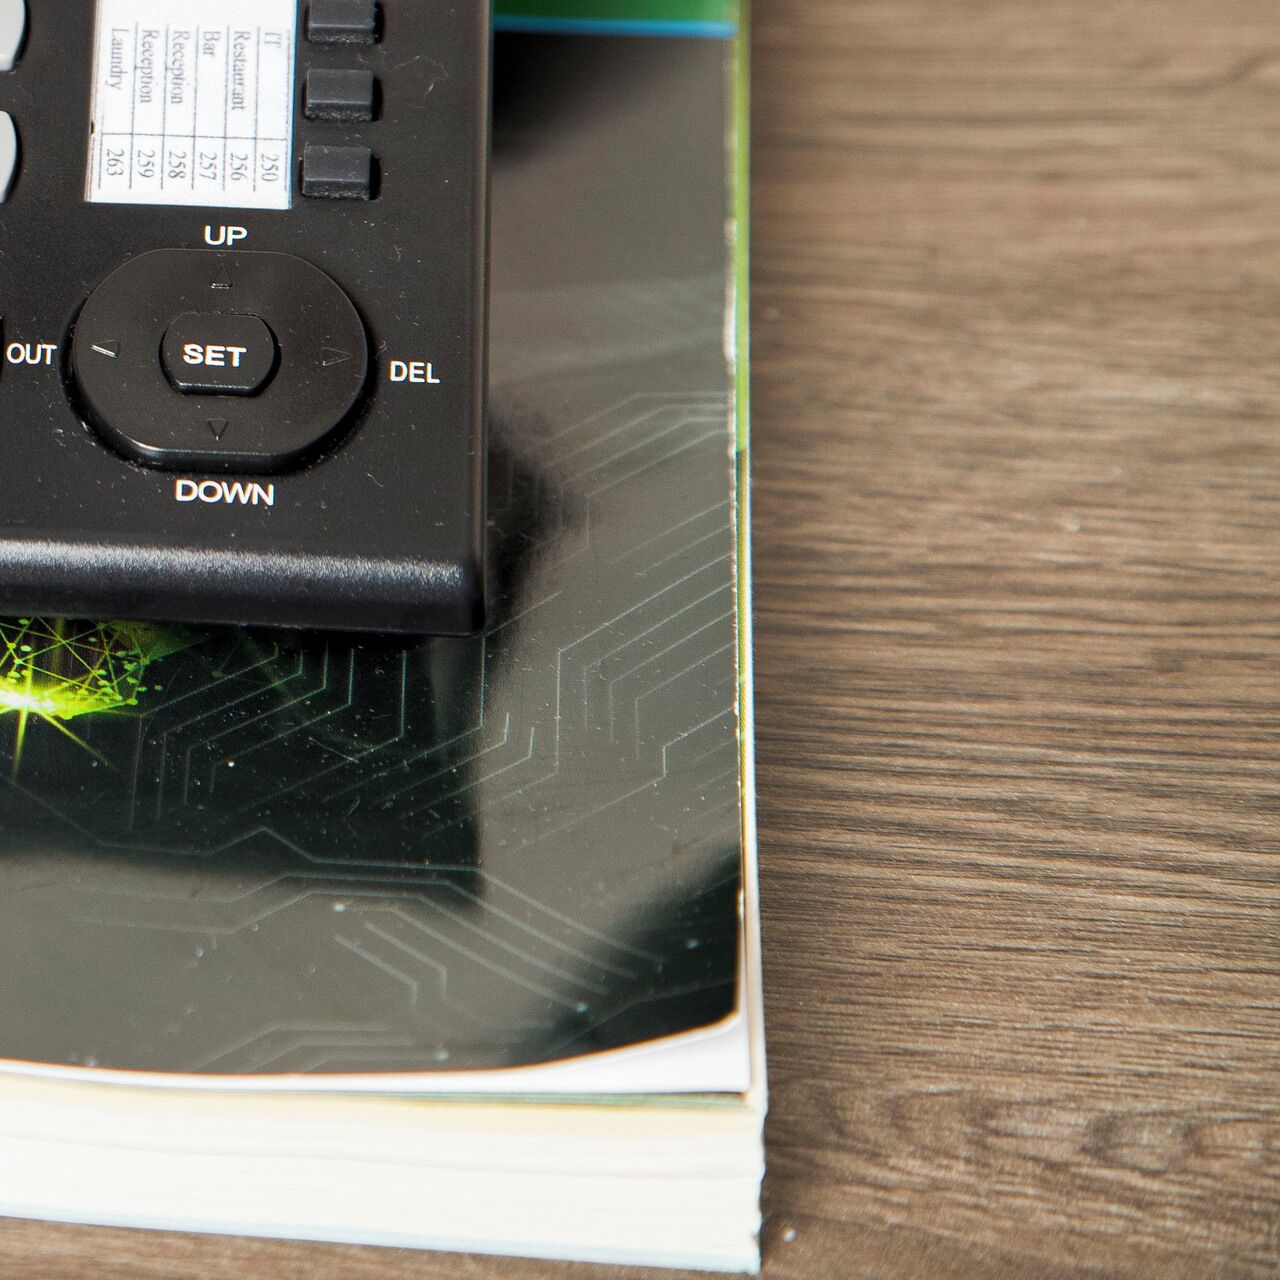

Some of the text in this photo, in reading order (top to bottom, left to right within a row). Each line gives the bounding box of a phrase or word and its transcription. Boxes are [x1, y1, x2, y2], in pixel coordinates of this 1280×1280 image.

[105, 27, 129, 176] Laundry 263
[135, 29, 159, 178] Reception 259
[166, 30, 190, 179] Reception 258
[199, 30, 222, 181] Bar 257
[230, 30, 251, 181] Restaurant 256
[261, 154, 279, 182] 250
[204, 225, 248, 246] UP
[6, 342, 58, 365] OUT
[183, 343, 247, 367] SET
[389, 360, 441, 384] DEL
[175, 479, 274, 506] DOWN
